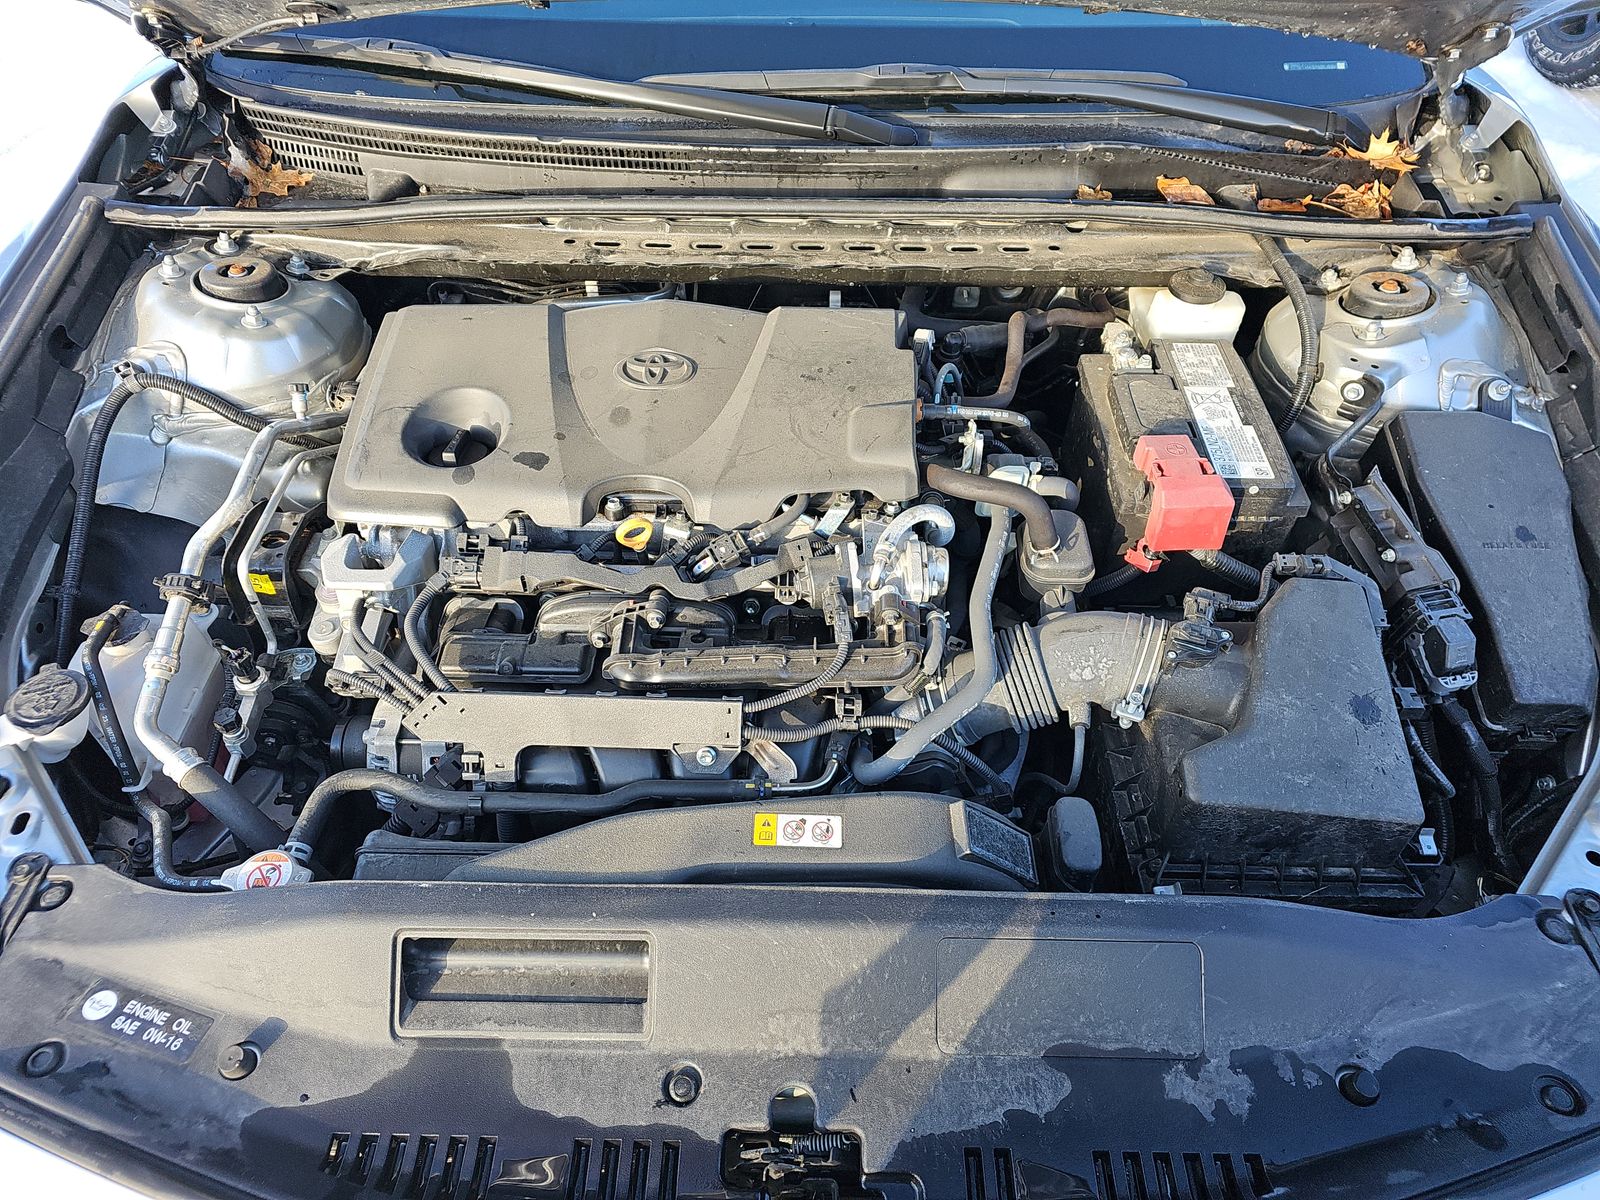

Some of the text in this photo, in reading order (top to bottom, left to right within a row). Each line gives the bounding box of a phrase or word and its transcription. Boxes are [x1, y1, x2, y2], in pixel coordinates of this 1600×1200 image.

[111, 1015, 184, 1051] SAE 0W-16
[123, 1000, 171, 1026] ENGINE
[172, 1018, 192, 1035] OIL
